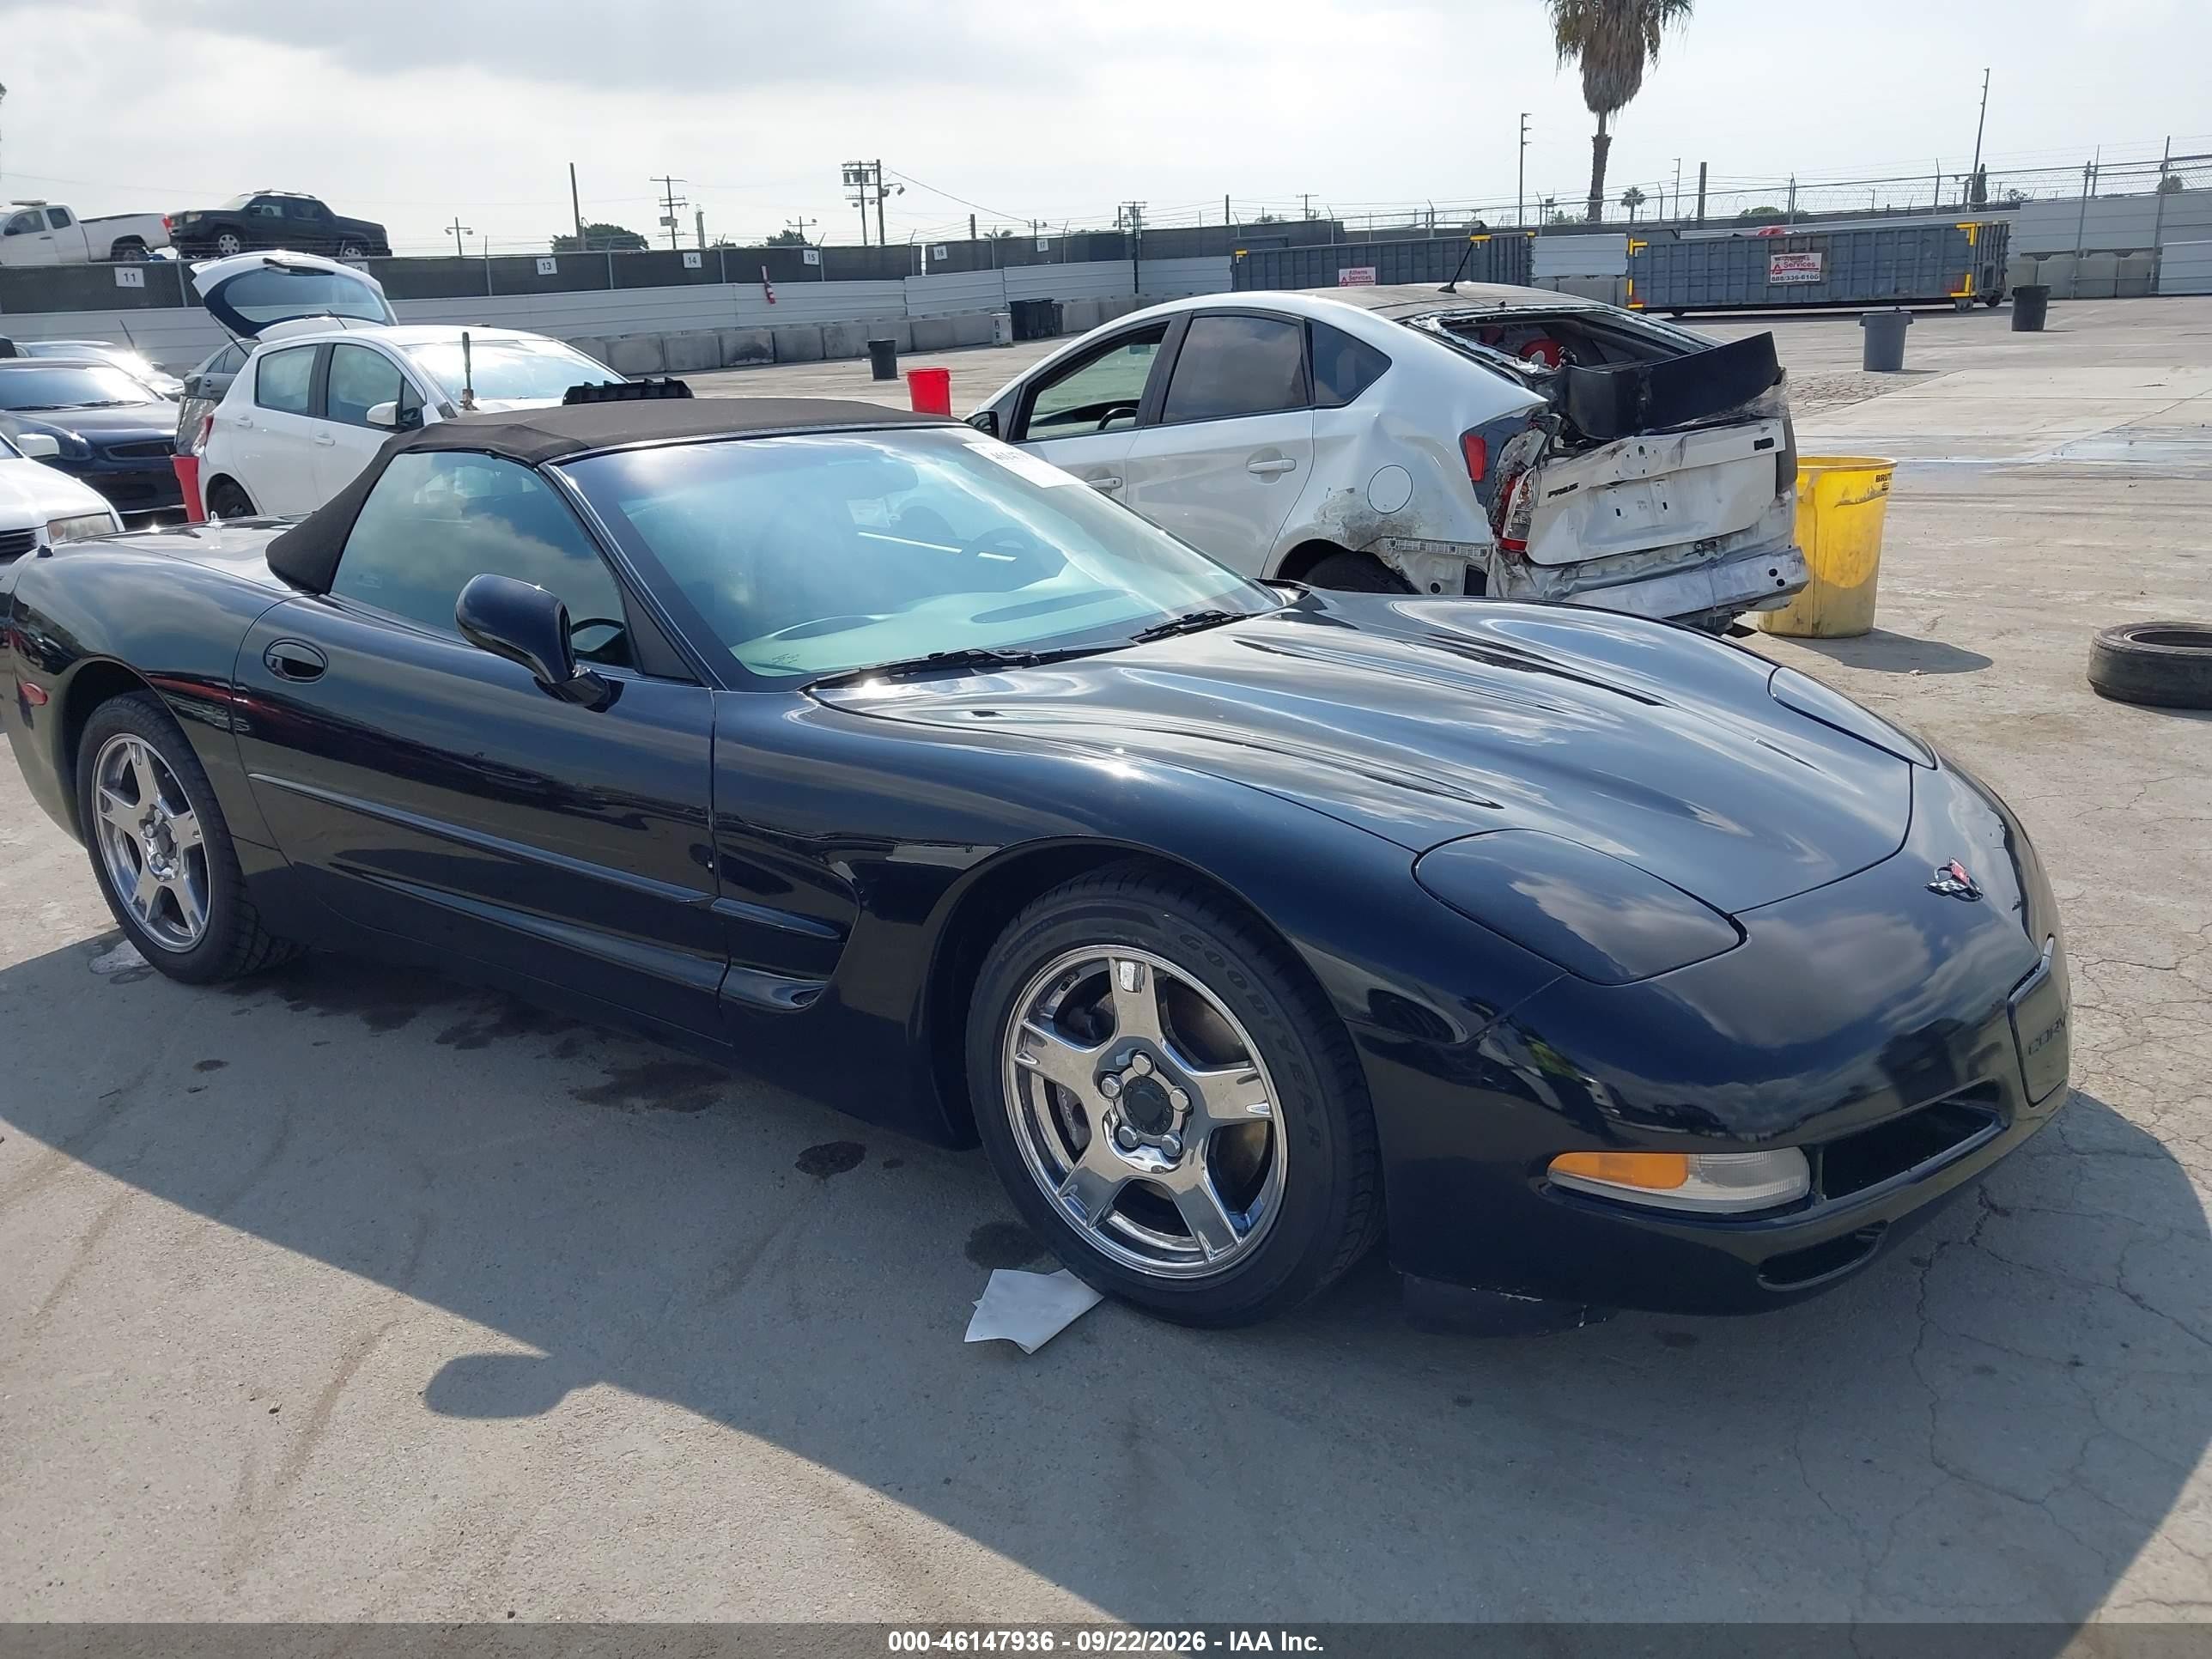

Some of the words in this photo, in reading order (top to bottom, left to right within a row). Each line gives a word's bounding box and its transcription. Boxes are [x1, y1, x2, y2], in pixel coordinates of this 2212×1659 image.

[542, 261, 552, 270] 13
[123, 272, 136, 283] 11
[1875, 472, 1893, 483] BRUT
[2027, 1014, 2067, 1056] CORV
[1177, 933, 1322, 1150] GOODYEAR
